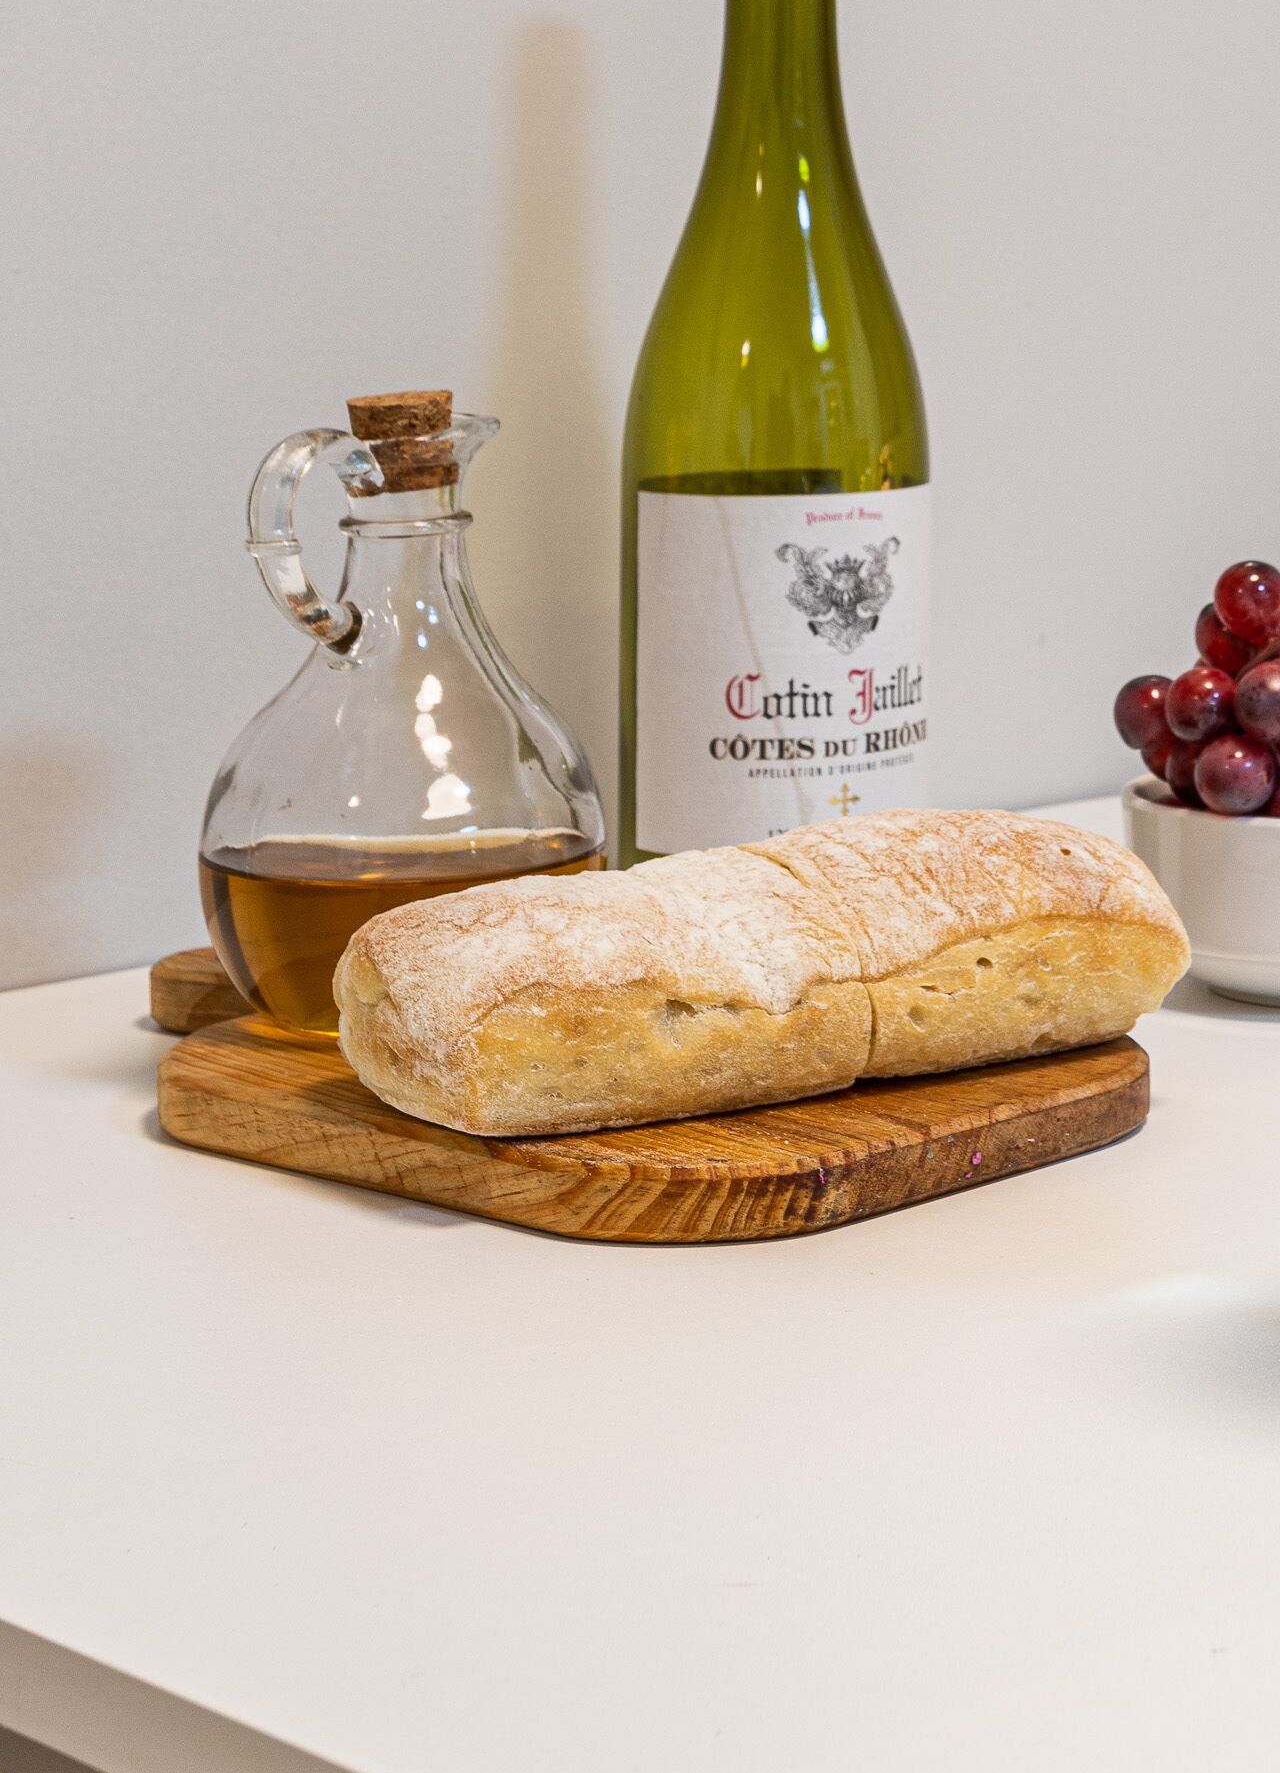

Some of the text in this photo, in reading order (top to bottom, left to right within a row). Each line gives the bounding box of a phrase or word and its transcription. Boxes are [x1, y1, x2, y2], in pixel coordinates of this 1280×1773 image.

[725, 672, 833, 720] Cotin
[709, 733, 815, 761] CÔTES
[824, 739, 857, 758] DU
[748, 766, 822, 779] APPELLATION
[828, 760, 877, 776] D'ORIGINE
